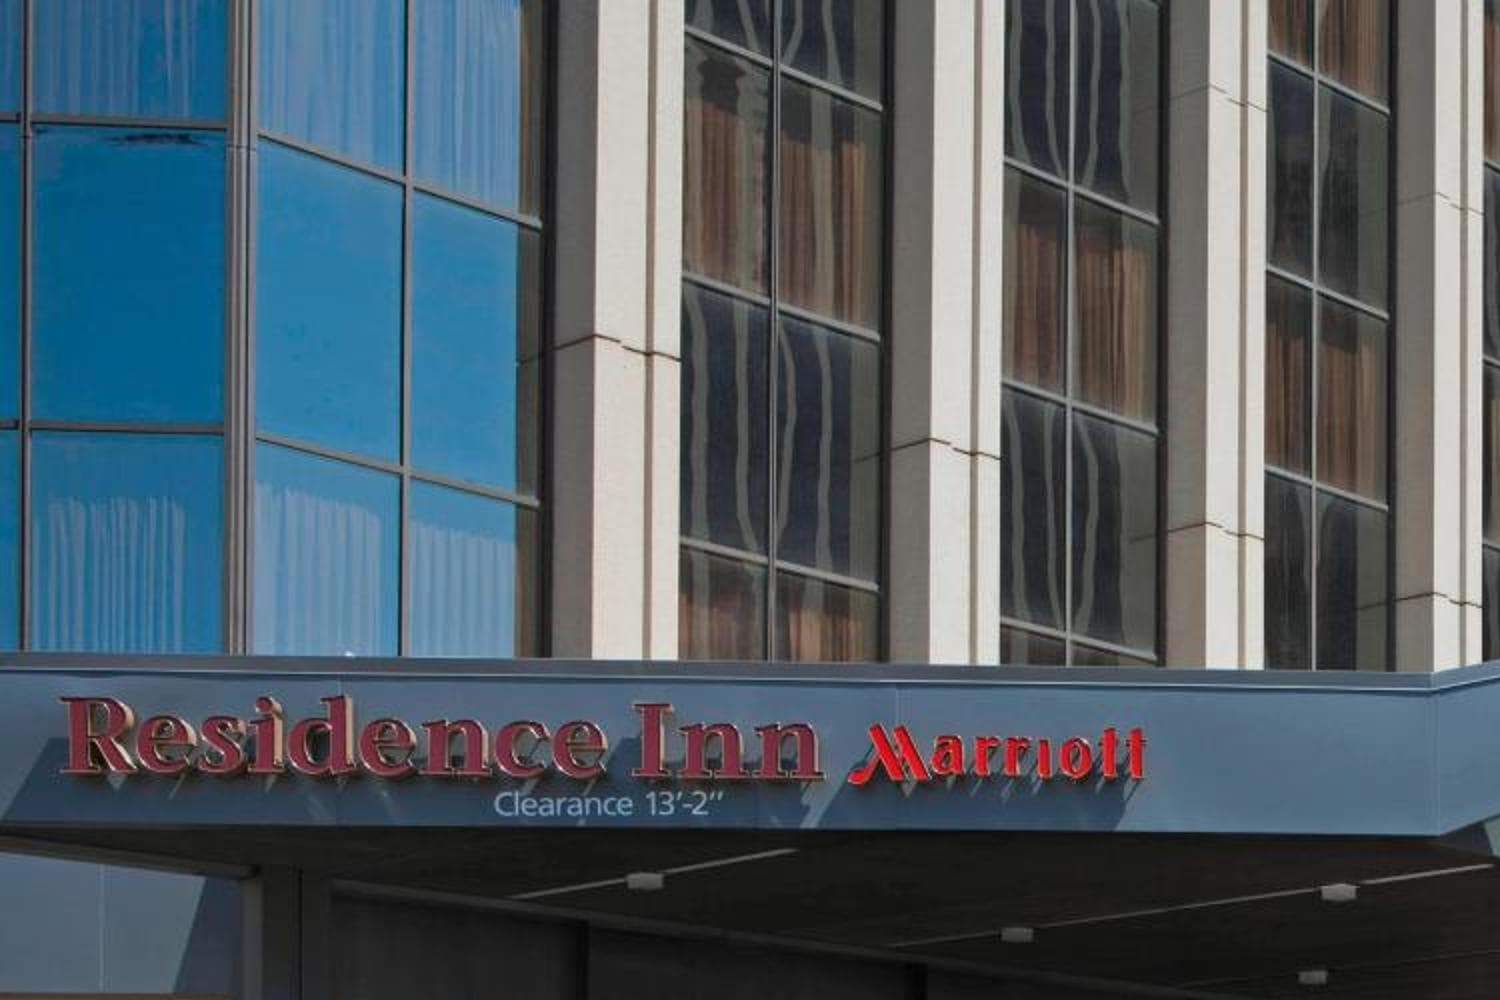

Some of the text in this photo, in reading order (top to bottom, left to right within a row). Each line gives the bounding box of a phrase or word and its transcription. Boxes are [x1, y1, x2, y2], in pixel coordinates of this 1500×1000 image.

[60, 695, 826, 779] Residence Inn
[847, 722, 1147, 784] Marriott
[493, 791, 634, 817] Clearance
